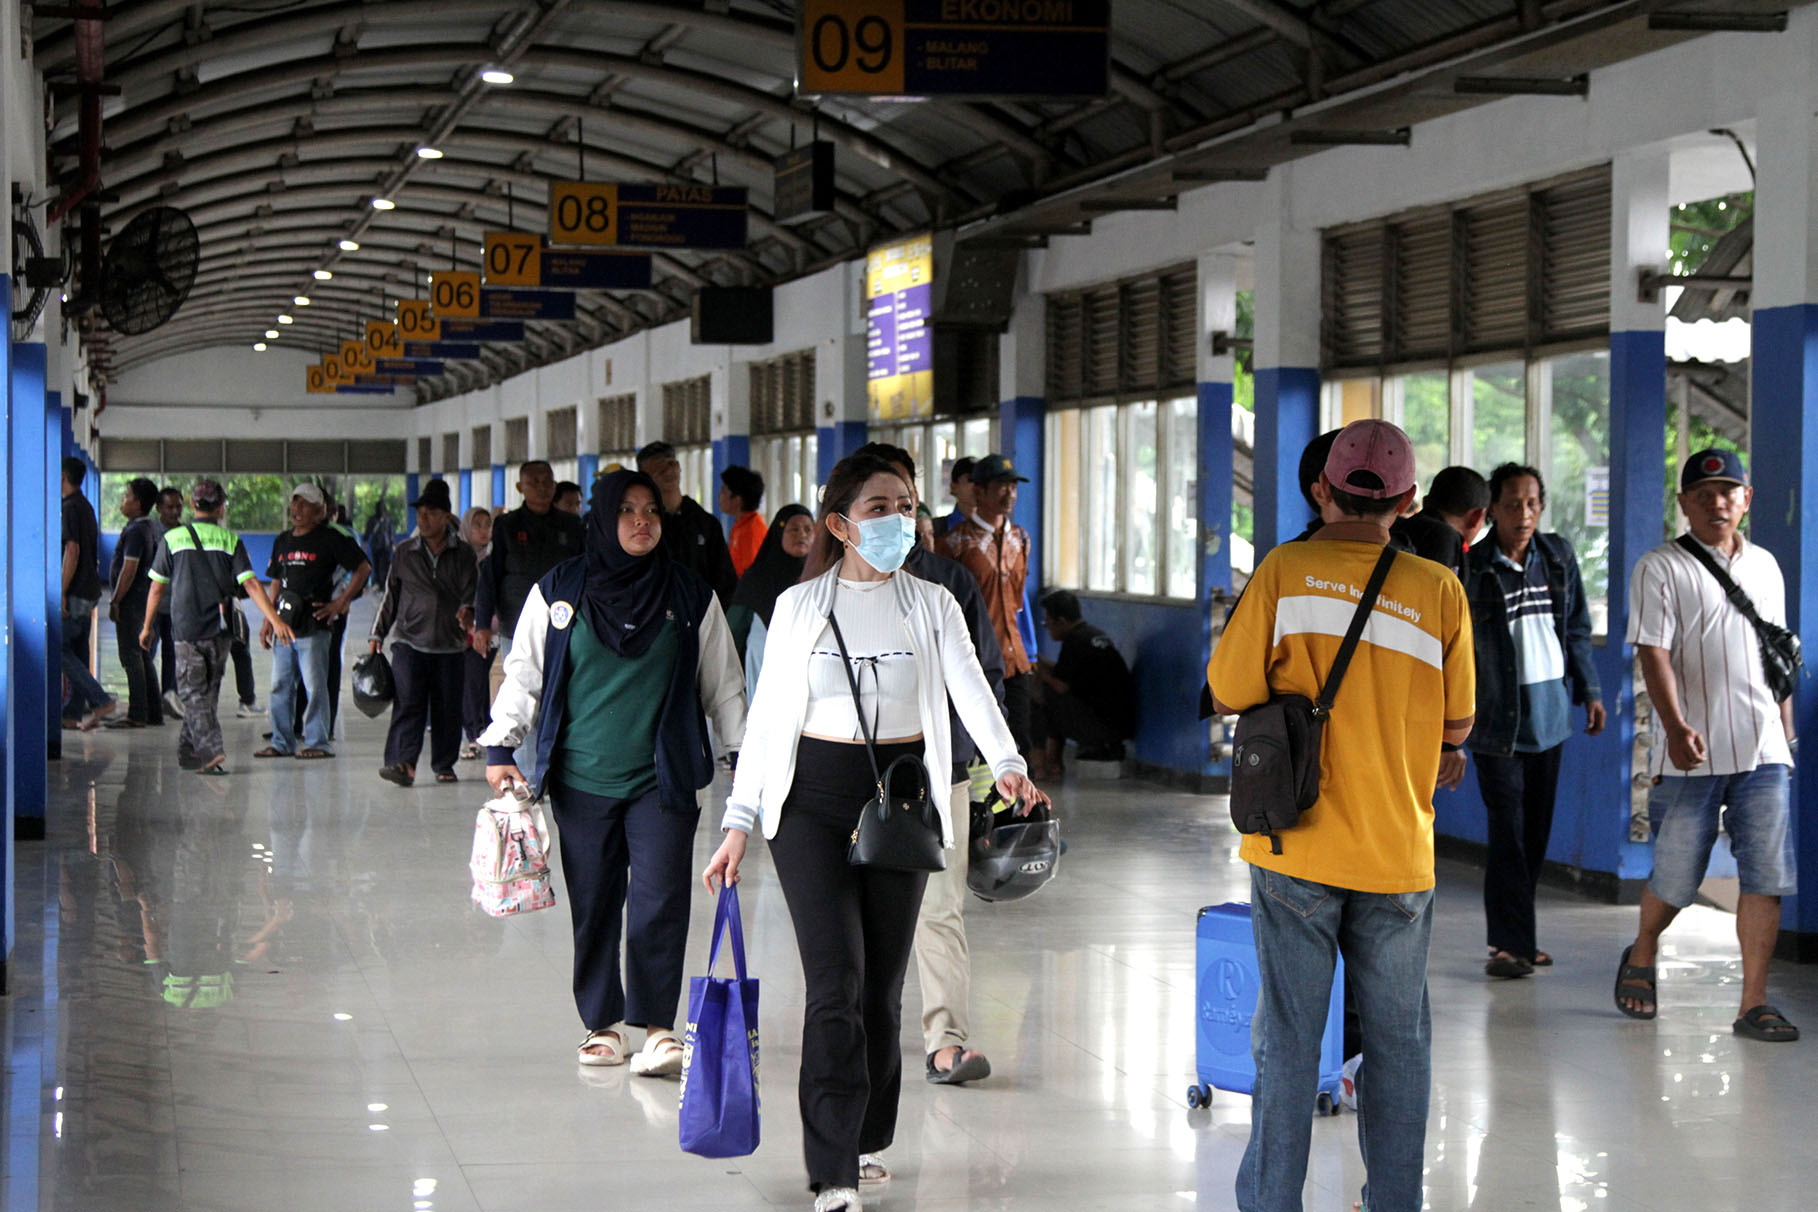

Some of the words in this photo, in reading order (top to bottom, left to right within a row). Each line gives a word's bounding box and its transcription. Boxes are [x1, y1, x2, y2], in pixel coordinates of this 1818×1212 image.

[940, 0, 1073, 23] EKONOMI
[811, 13, 893, 74] 09
[924, 40, 990, 55] MALANG
[924, 56, 978, 71] BLITAR
[656, 185, 713, 203] PATAS
[558, 194, 609, 232] 08
[490, 242, 534, 275] 07
[436, 280, 474, 309] 06
[401, 307, 435, 333] 05
[368, 328, 399, 351] 04
[1304, 575, 1347, 593] Serve
[1349, 584, 1422, 623] Infinitely
